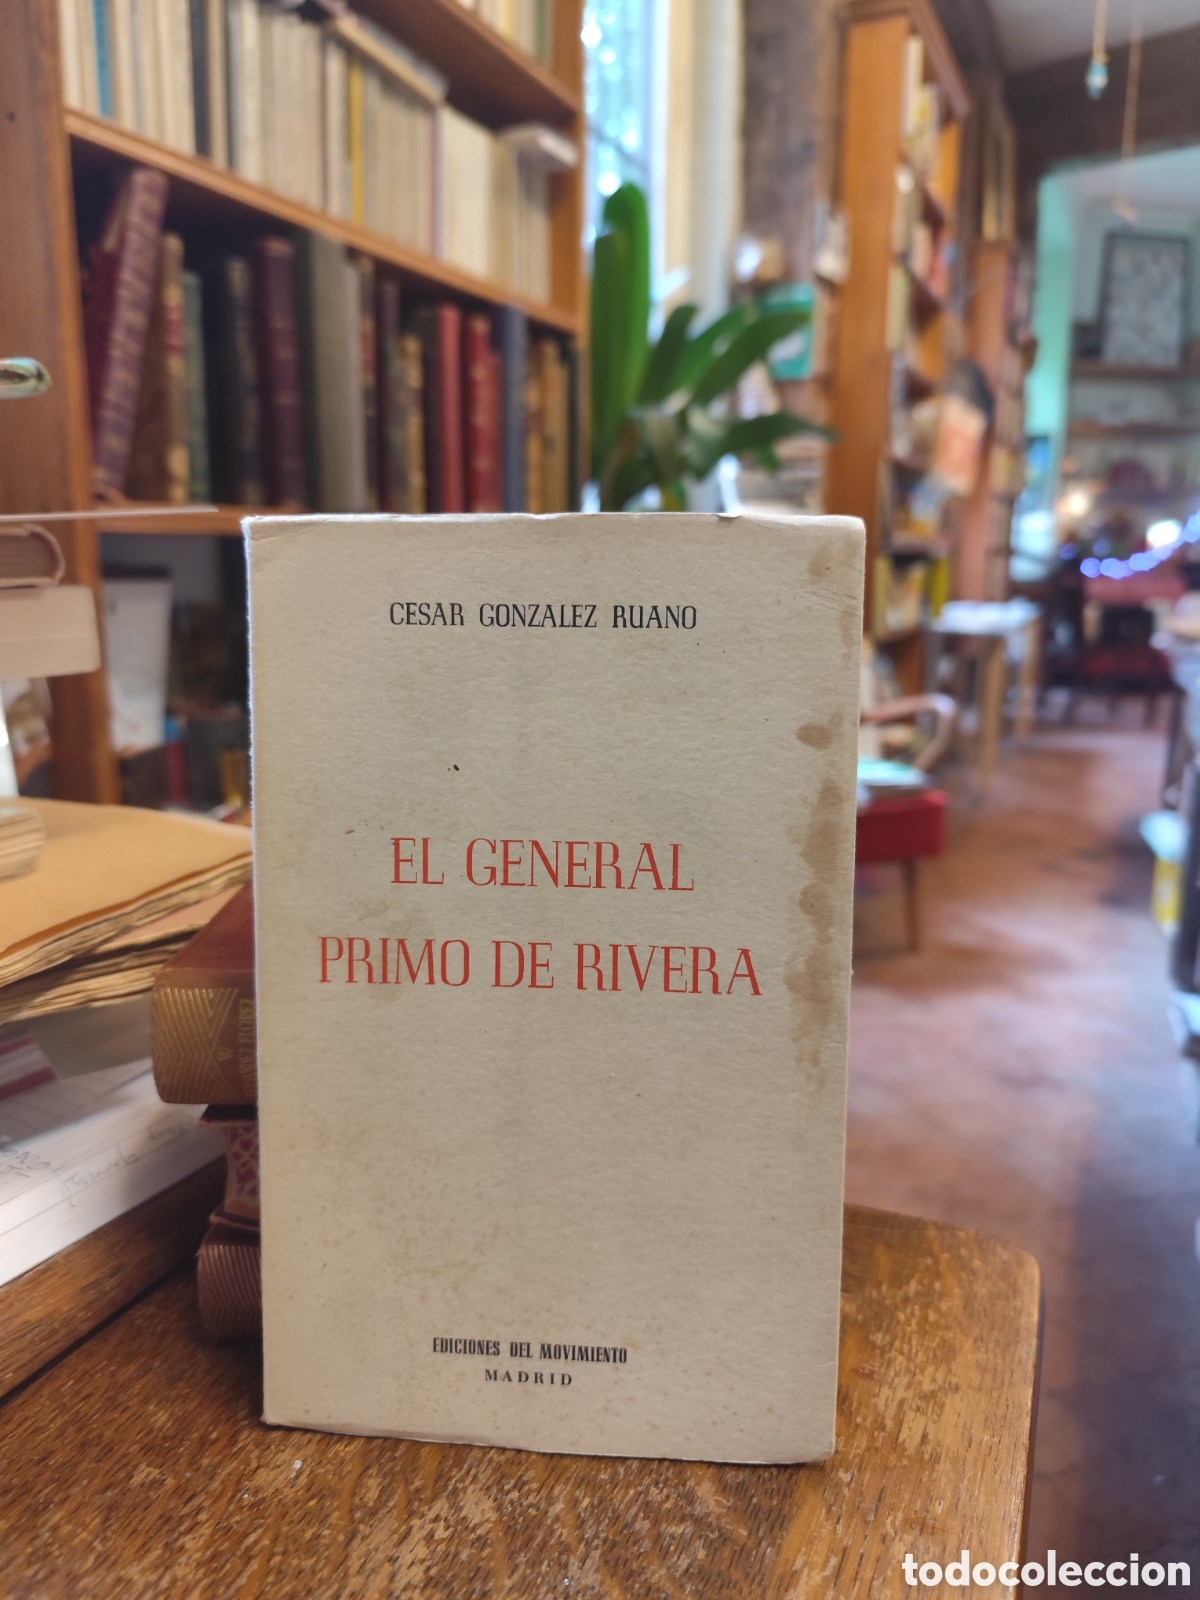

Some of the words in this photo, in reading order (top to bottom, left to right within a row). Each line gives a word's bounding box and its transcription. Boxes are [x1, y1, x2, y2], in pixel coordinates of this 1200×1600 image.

[389, 602, 465, 626] CESAR
[479, 603, 597, 628] GONZALEZ
[612, 605, 697, 630] RUANO
[391, 837, 444, 885] EL
[465, 838, 694, 891] GENERAL
[318, 936, 470, 987] PRIMO
[492, 940, 554, 989] DE
[574, 943, 763, 996] RIVERA
[433, 1337, 501, 1357] EDICIONES
[510, 1341, 533, 1359] DEL
[539, 1343, 628, 1364] MOVIMIENTO
[484, 1369, 573, 1386] MADRID
